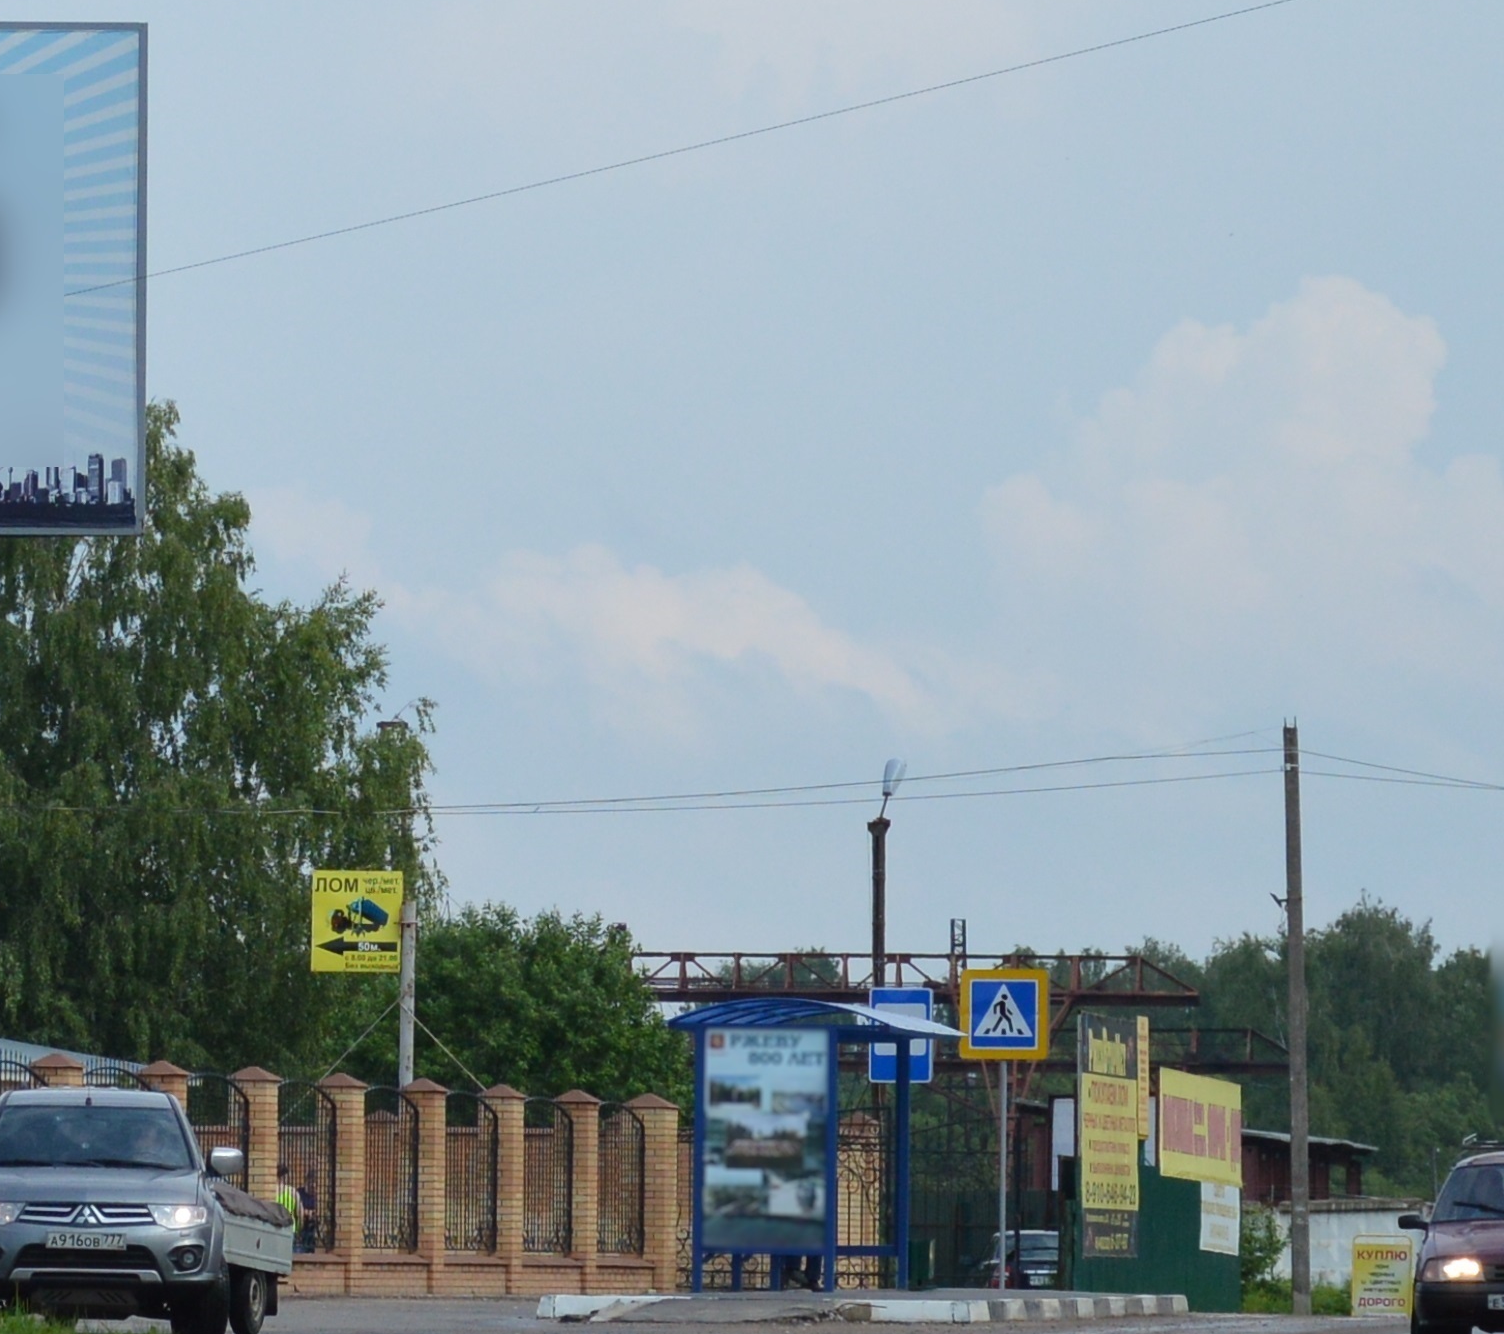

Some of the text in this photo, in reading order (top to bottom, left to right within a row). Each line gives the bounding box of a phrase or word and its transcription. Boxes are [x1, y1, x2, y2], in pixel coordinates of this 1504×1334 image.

[315, 877, 358, 892] ЛОМ
[730, 1033, 803, 1047] РЖЕВУ
[788, 1051, 825, 1065] ЛЕТ
[103, 1233, 123, 1245] 777
[1357, 1250, 1407, 1261] КУПЛЮ
[1358, 1297, 1405, 1307] ДОРОГО
